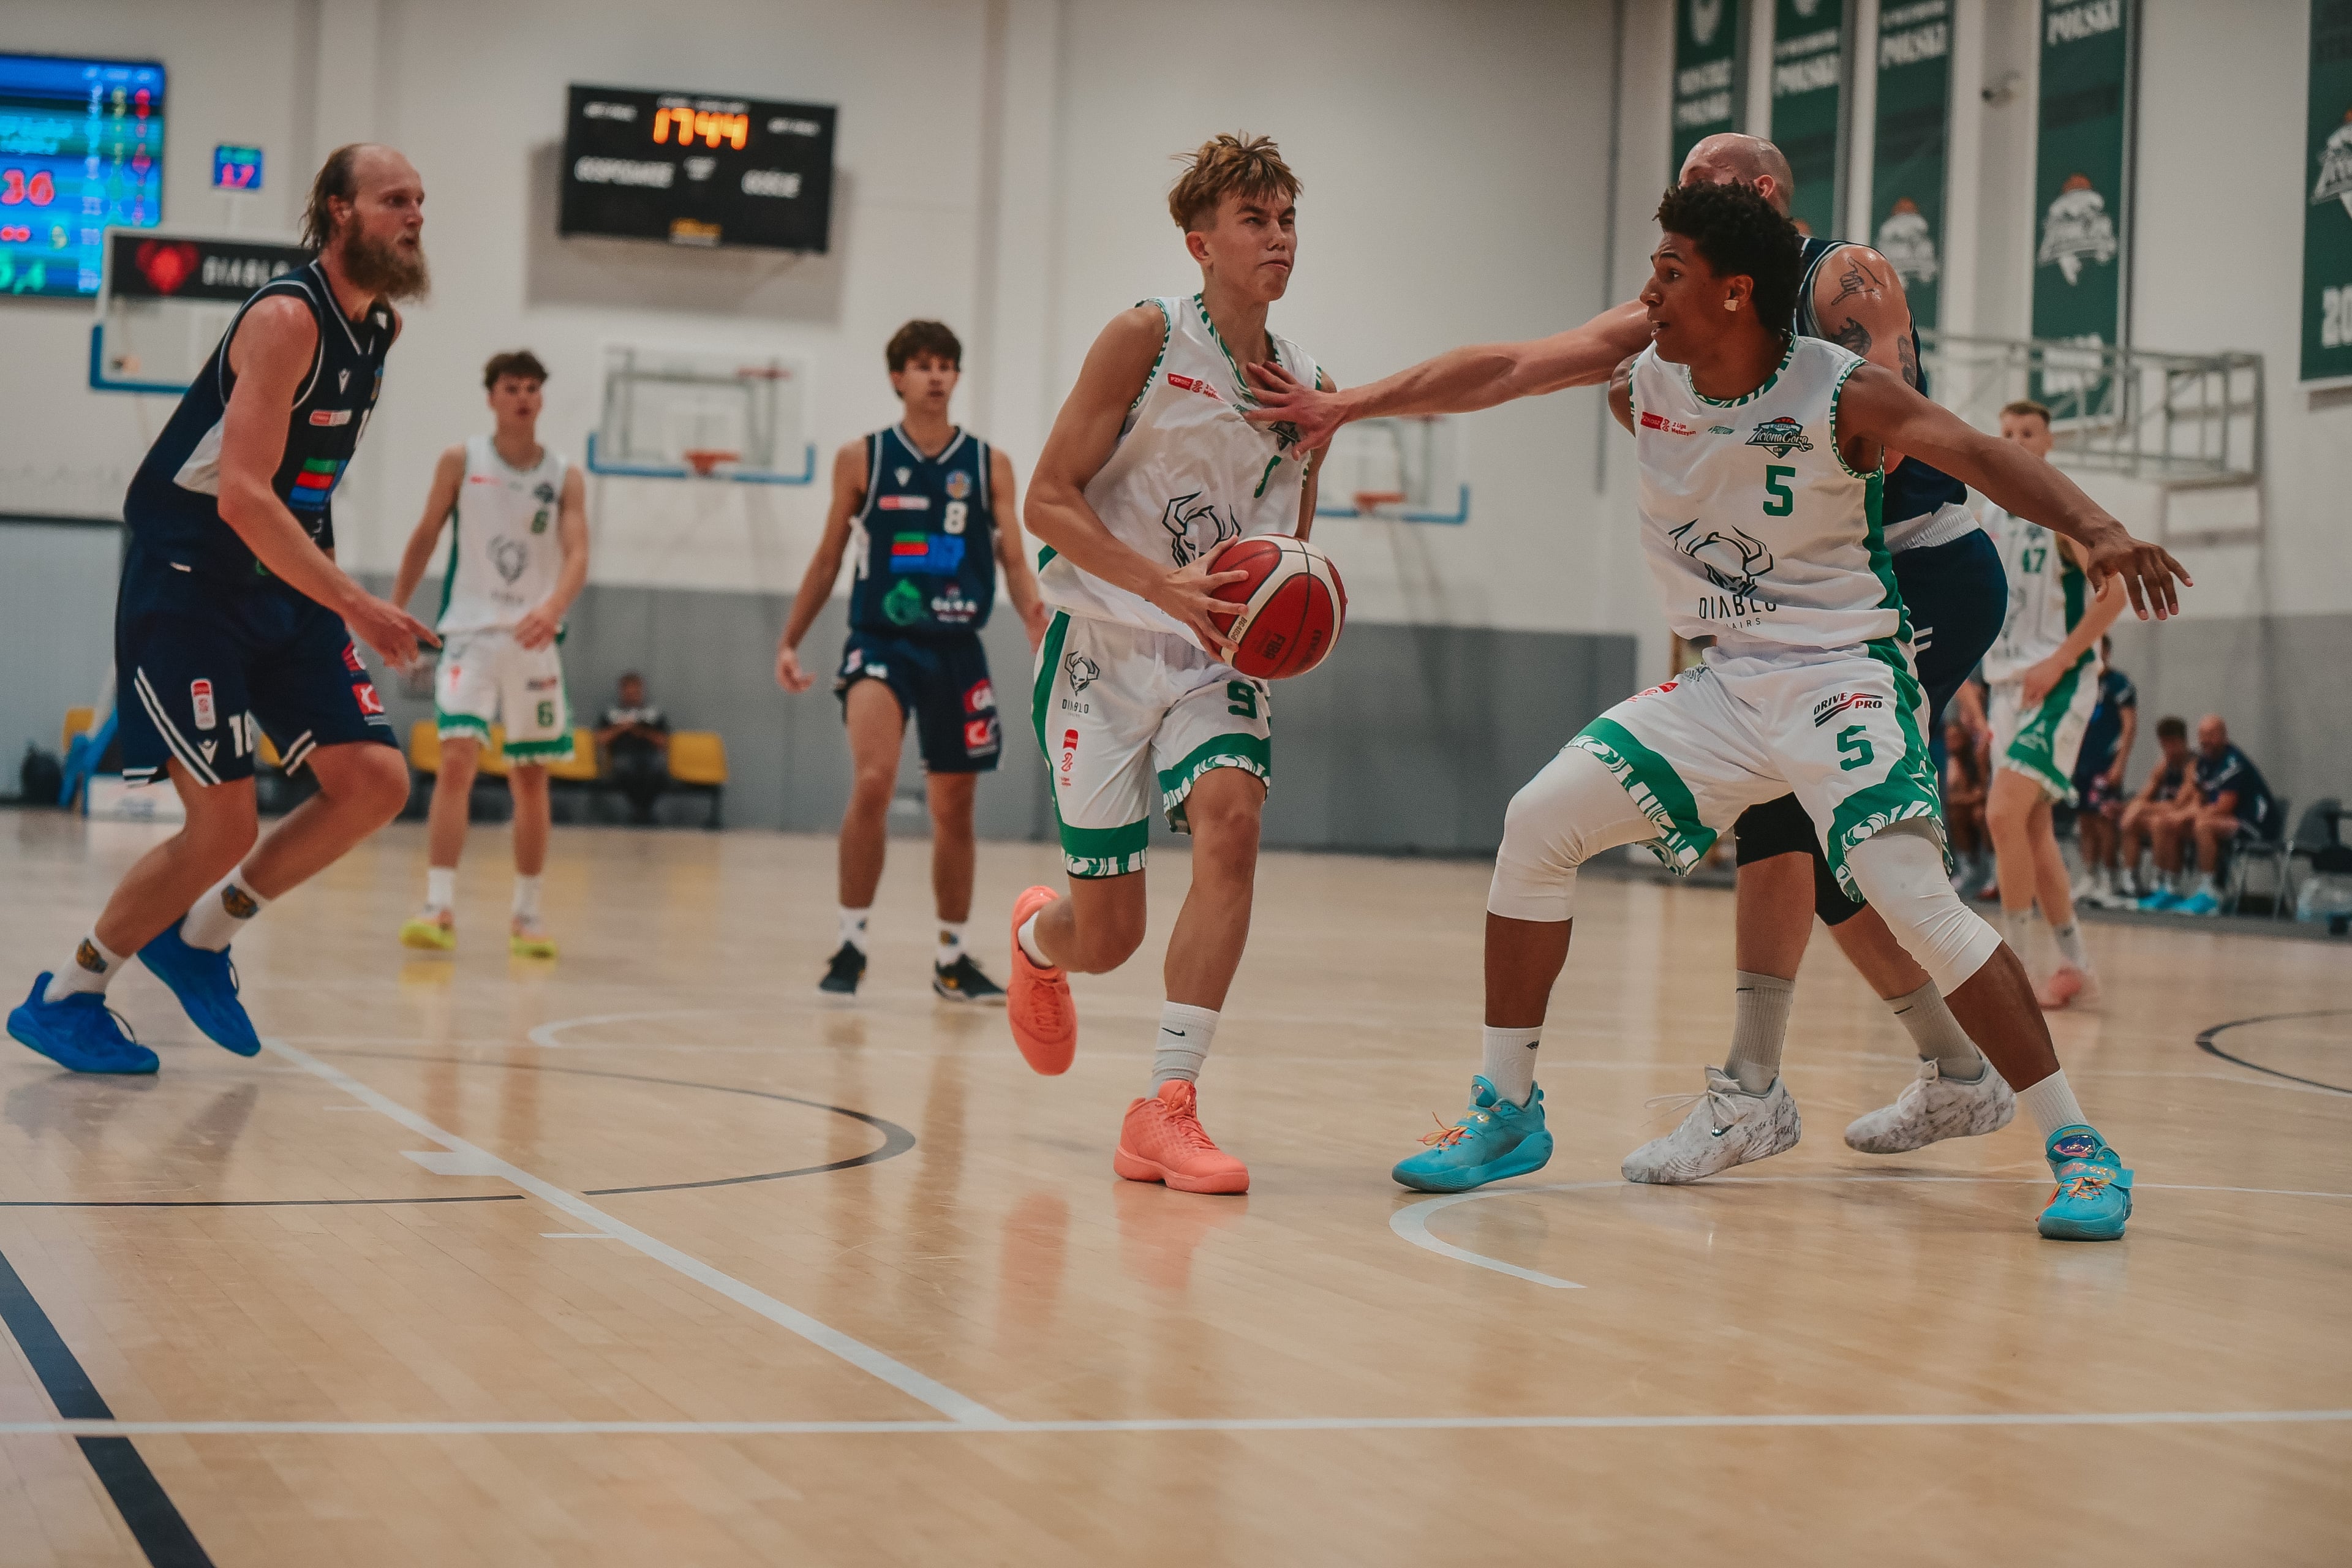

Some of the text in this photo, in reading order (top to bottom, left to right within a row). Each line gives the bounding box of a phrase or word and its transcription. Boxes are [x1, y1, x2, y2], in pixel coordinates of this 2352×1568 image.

[1763, 464, 1796, 517] 5
[943, 500, 968, 535] 8
[1724, 617, 1762, 629] AIRS
[1227, 681, 1258, 719] 9
[1813, 692, 1848, 715] DRIVE
[1855, 700, 1883, 709] PRO
[1837, 725, 1874, 772] 5
